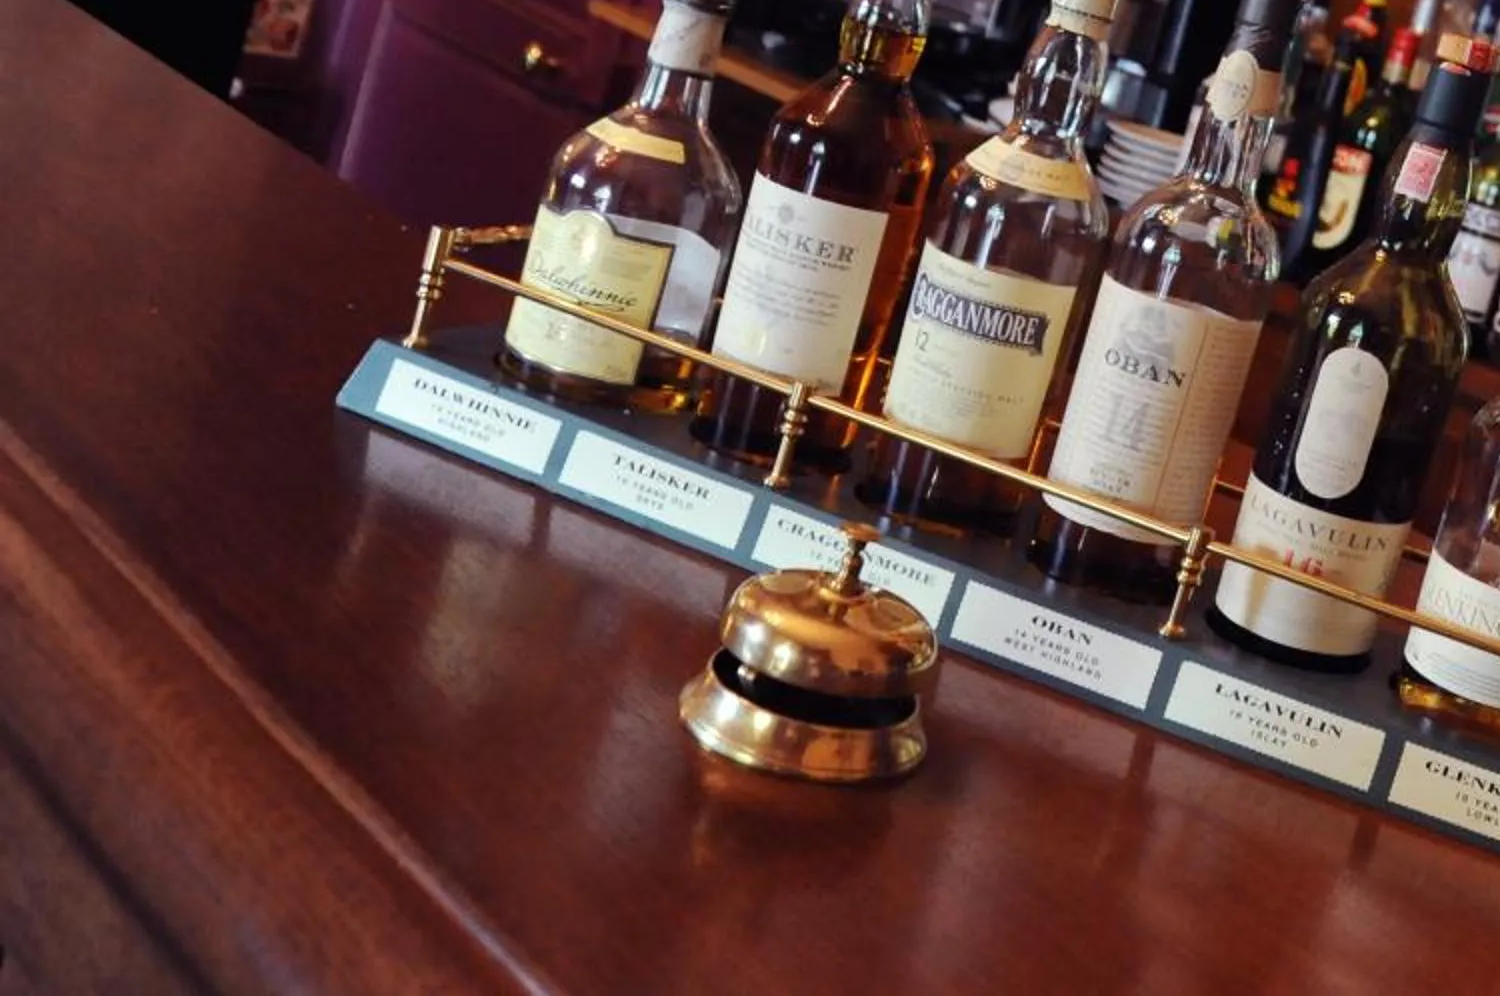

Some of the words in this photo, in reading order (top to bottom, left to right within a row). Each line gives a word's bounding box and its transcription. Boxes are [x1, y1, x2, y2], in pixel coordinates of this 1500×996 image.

[1104, 346, 1186, 388] OBAN
[414, 377, 536, 435] DALWHINNIE
[614, 454, 712, 500] TALISKER
[1250, 492, 1391, 552] LAGAVULIN
[777, 518, 936, 586] CRAGGNMORE
[1031, 614, 1094, 646] OBAN
[1033, 632, 1070, 656] YEARS
[1076, 650, 1100, 667] OLD
[1214, 682, 1344, 740] LAGAVULIN
[1248, 715, 1289, 737] YEARS
[1293, 732, 1320, 749] OLD
